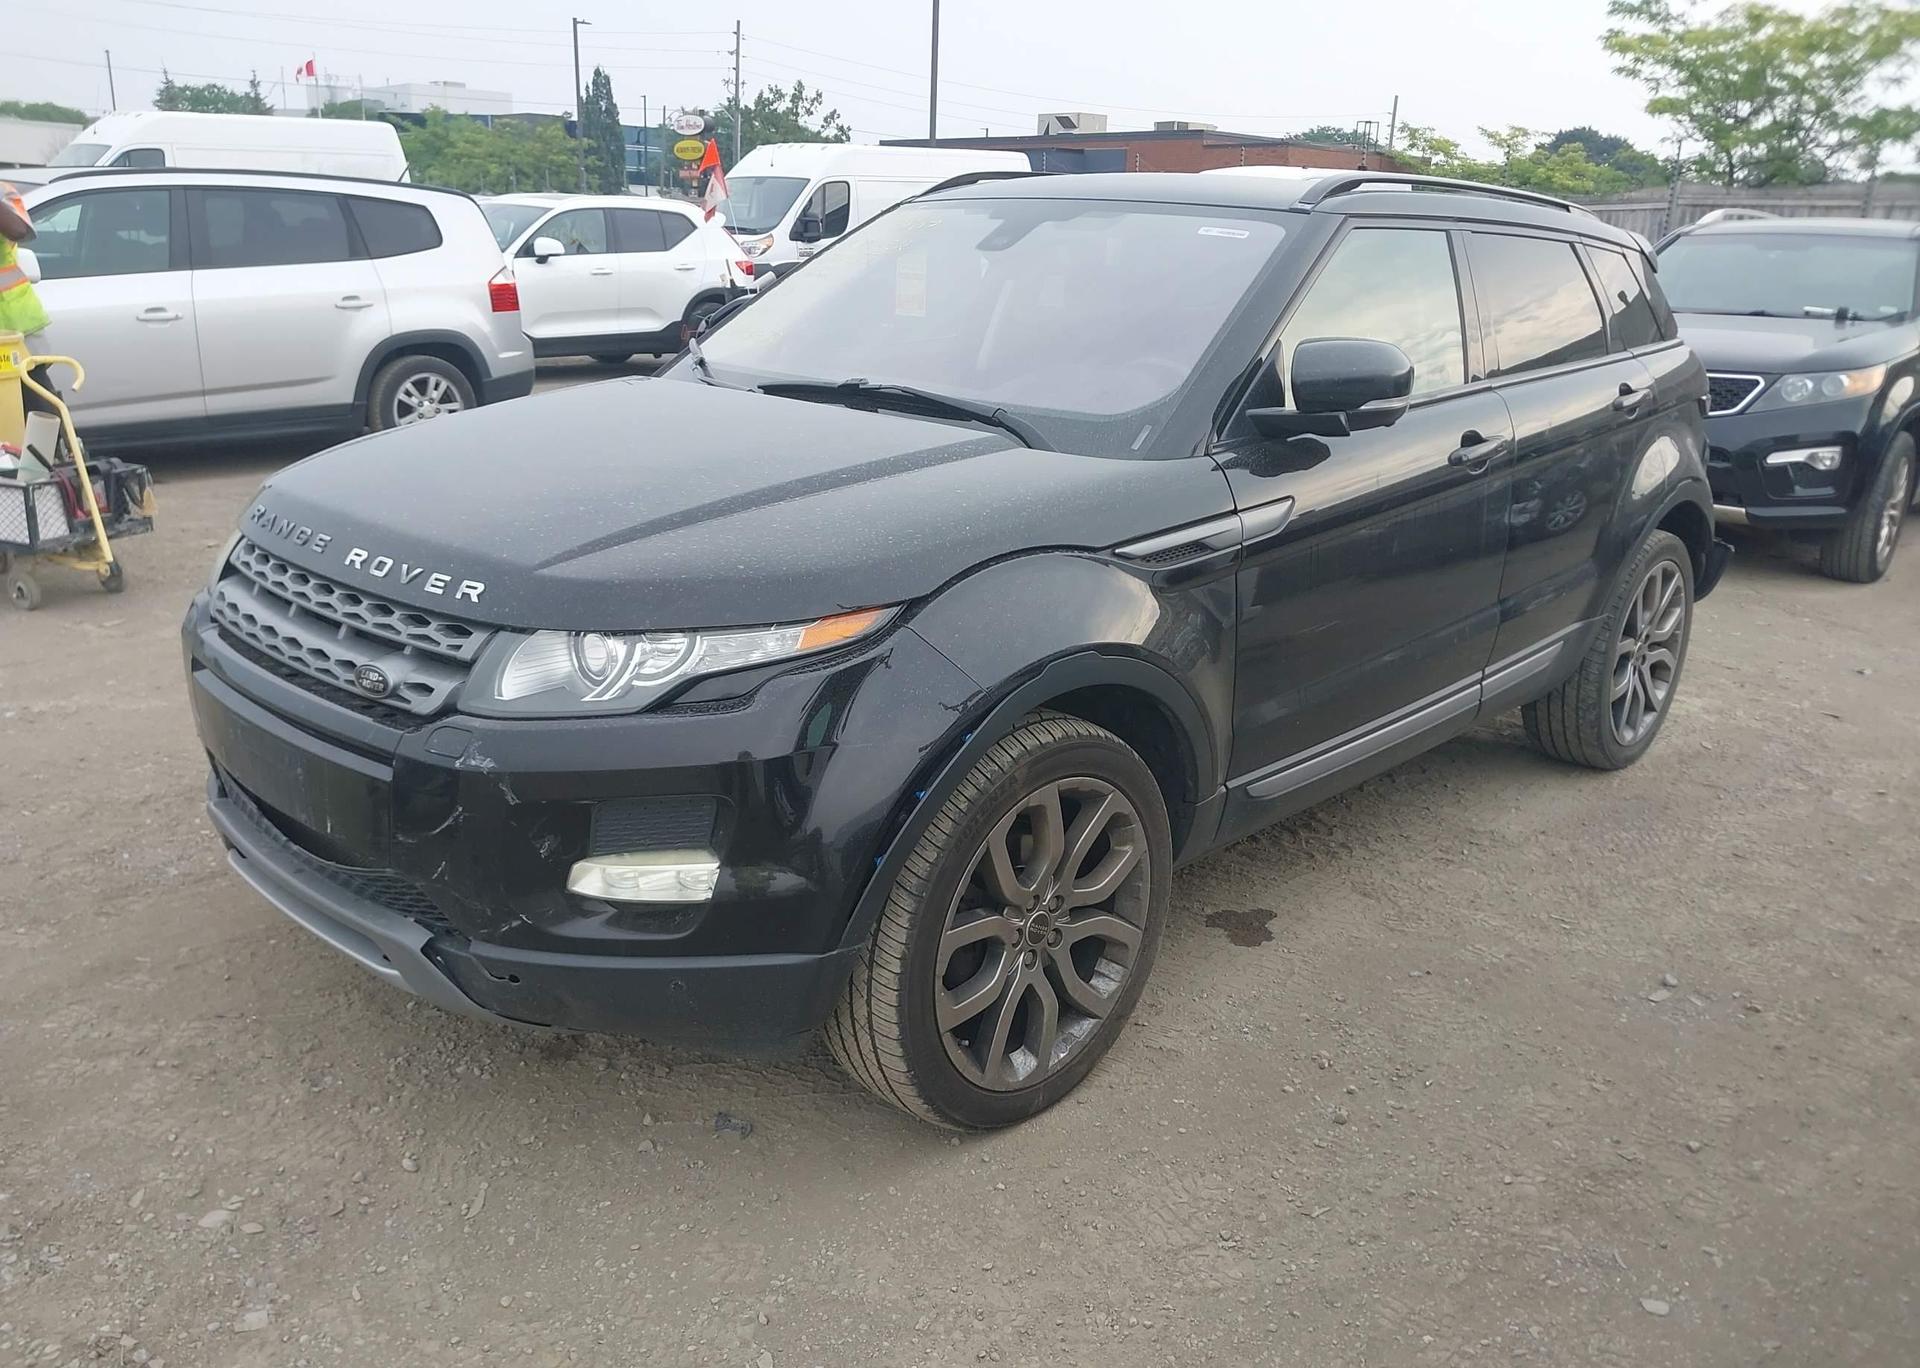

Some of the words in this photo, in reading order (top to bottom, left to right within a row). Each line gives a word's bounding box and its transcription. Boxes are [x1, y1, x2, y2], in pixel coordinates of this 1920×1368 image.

[251, 504, 332, 553] RANGE
[344, 547, 486, 603] ROVER
[360, 670, 379, 681] LAND
[361, 678, 384, 692] ROVER
